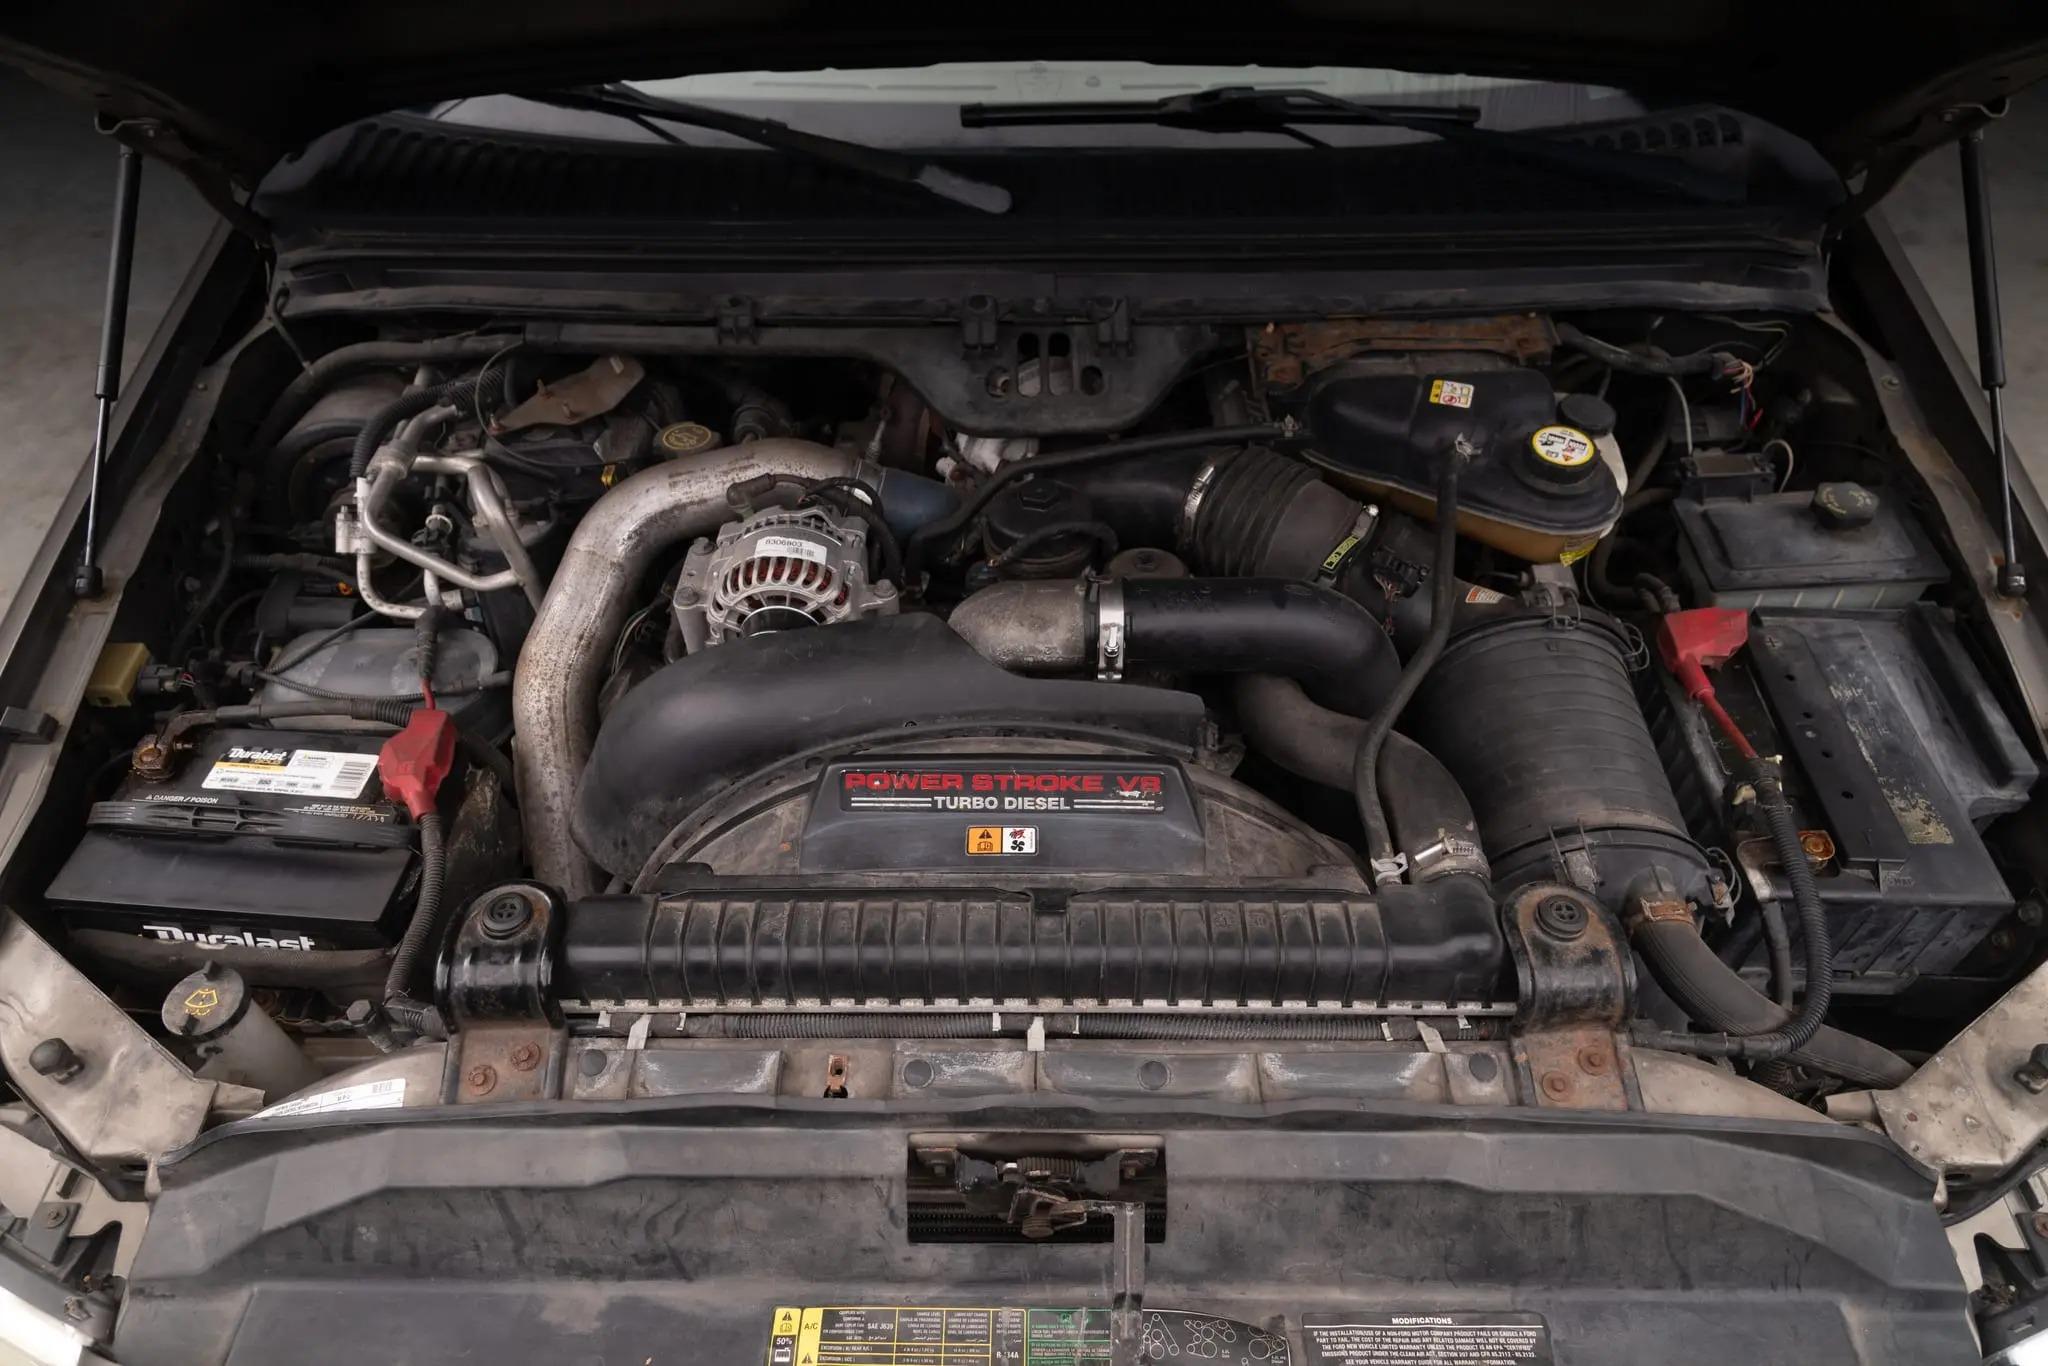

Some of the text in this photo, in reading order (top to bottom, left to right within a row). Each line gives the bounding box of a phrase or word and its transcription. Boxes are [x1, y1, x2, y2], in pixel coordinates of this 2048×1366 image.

[229, 748, 287, 760] Duralast
[845, 773, 964, 792] POWER
[971, 773, 1104, 792] STROKE
[153, 794, 184, 802] DANGER
[190, 796, 218, 804] POISON
[934, 797, 1070, 810] TURBO DIESEL
[143, 925, 316, 951] Duralast
[804, 1322, 819, 1330] A/C
[1391, 1317, 1453, 1325] MODIFICATIONS
[776, 1337, 793, 1345] 50%
